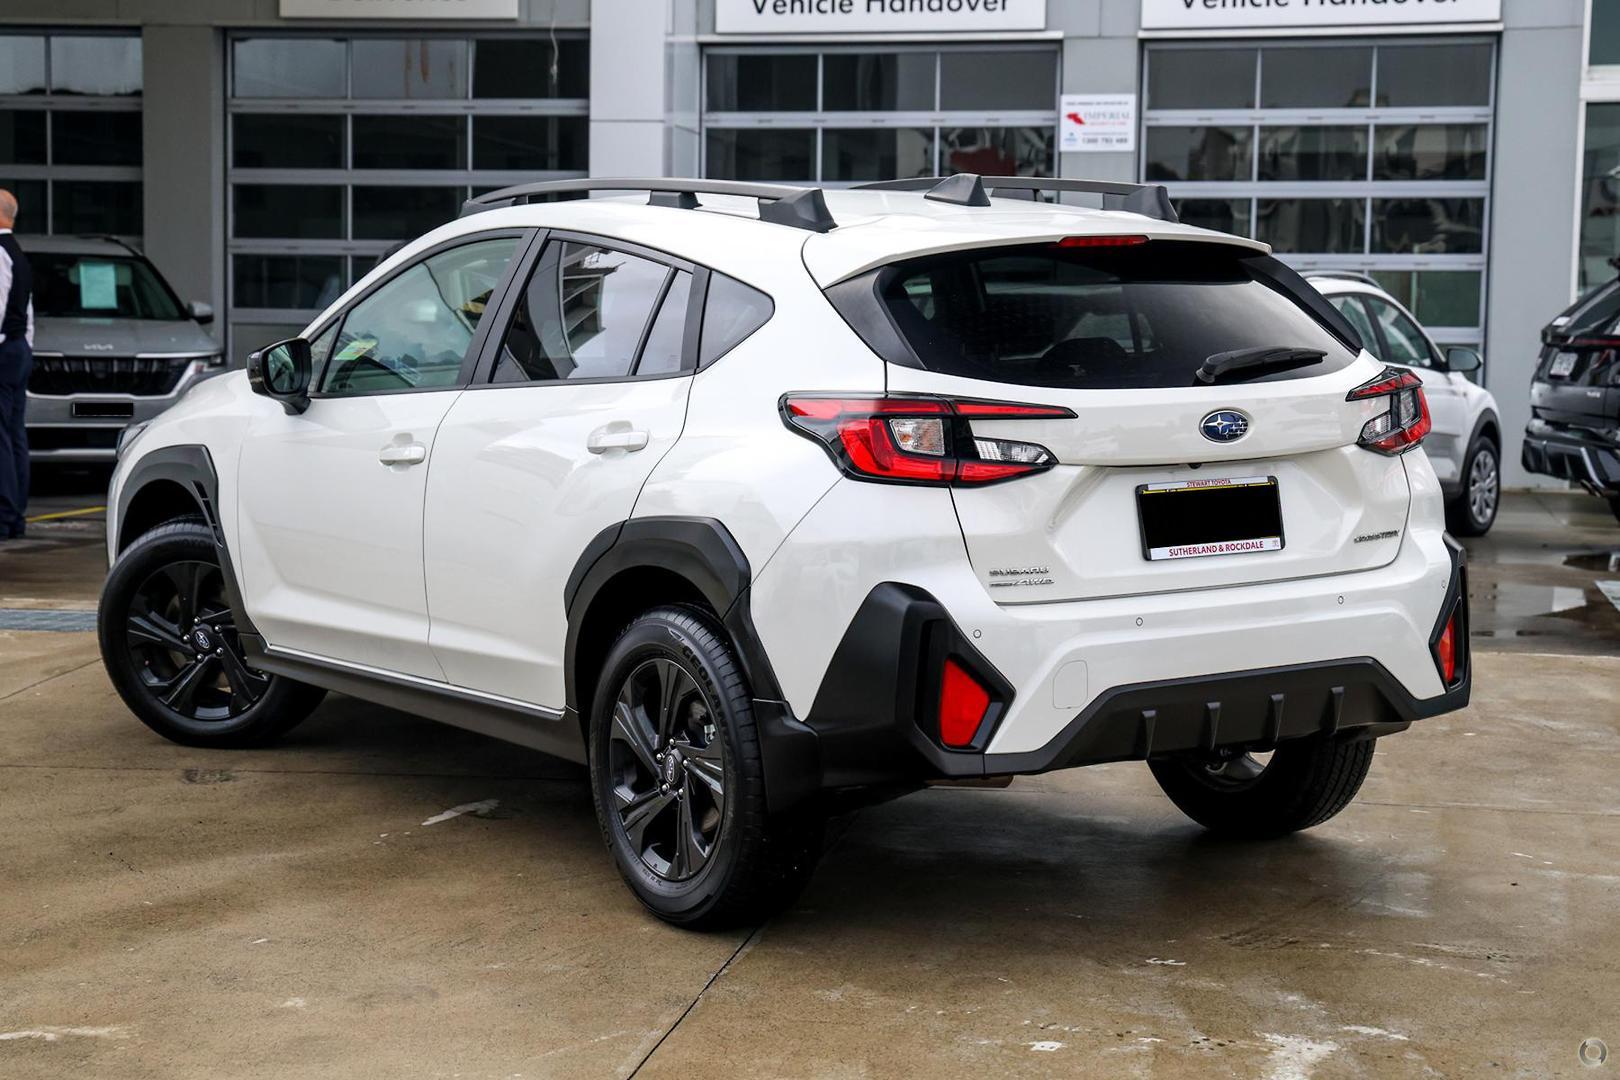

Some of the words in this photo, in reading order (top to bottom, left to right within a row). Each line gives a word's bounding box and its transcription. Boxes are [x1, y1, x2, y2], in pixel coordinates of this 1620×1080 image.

[753, 0, 853, 15] Vehicle
[1186, 480, 1211, 488] STEWART
[1168, 544, 1218, 557] SUTHERLAND
[1218, 544, 1224, 552] &
[1225, 540, 1264, 552] ROCKDALE
